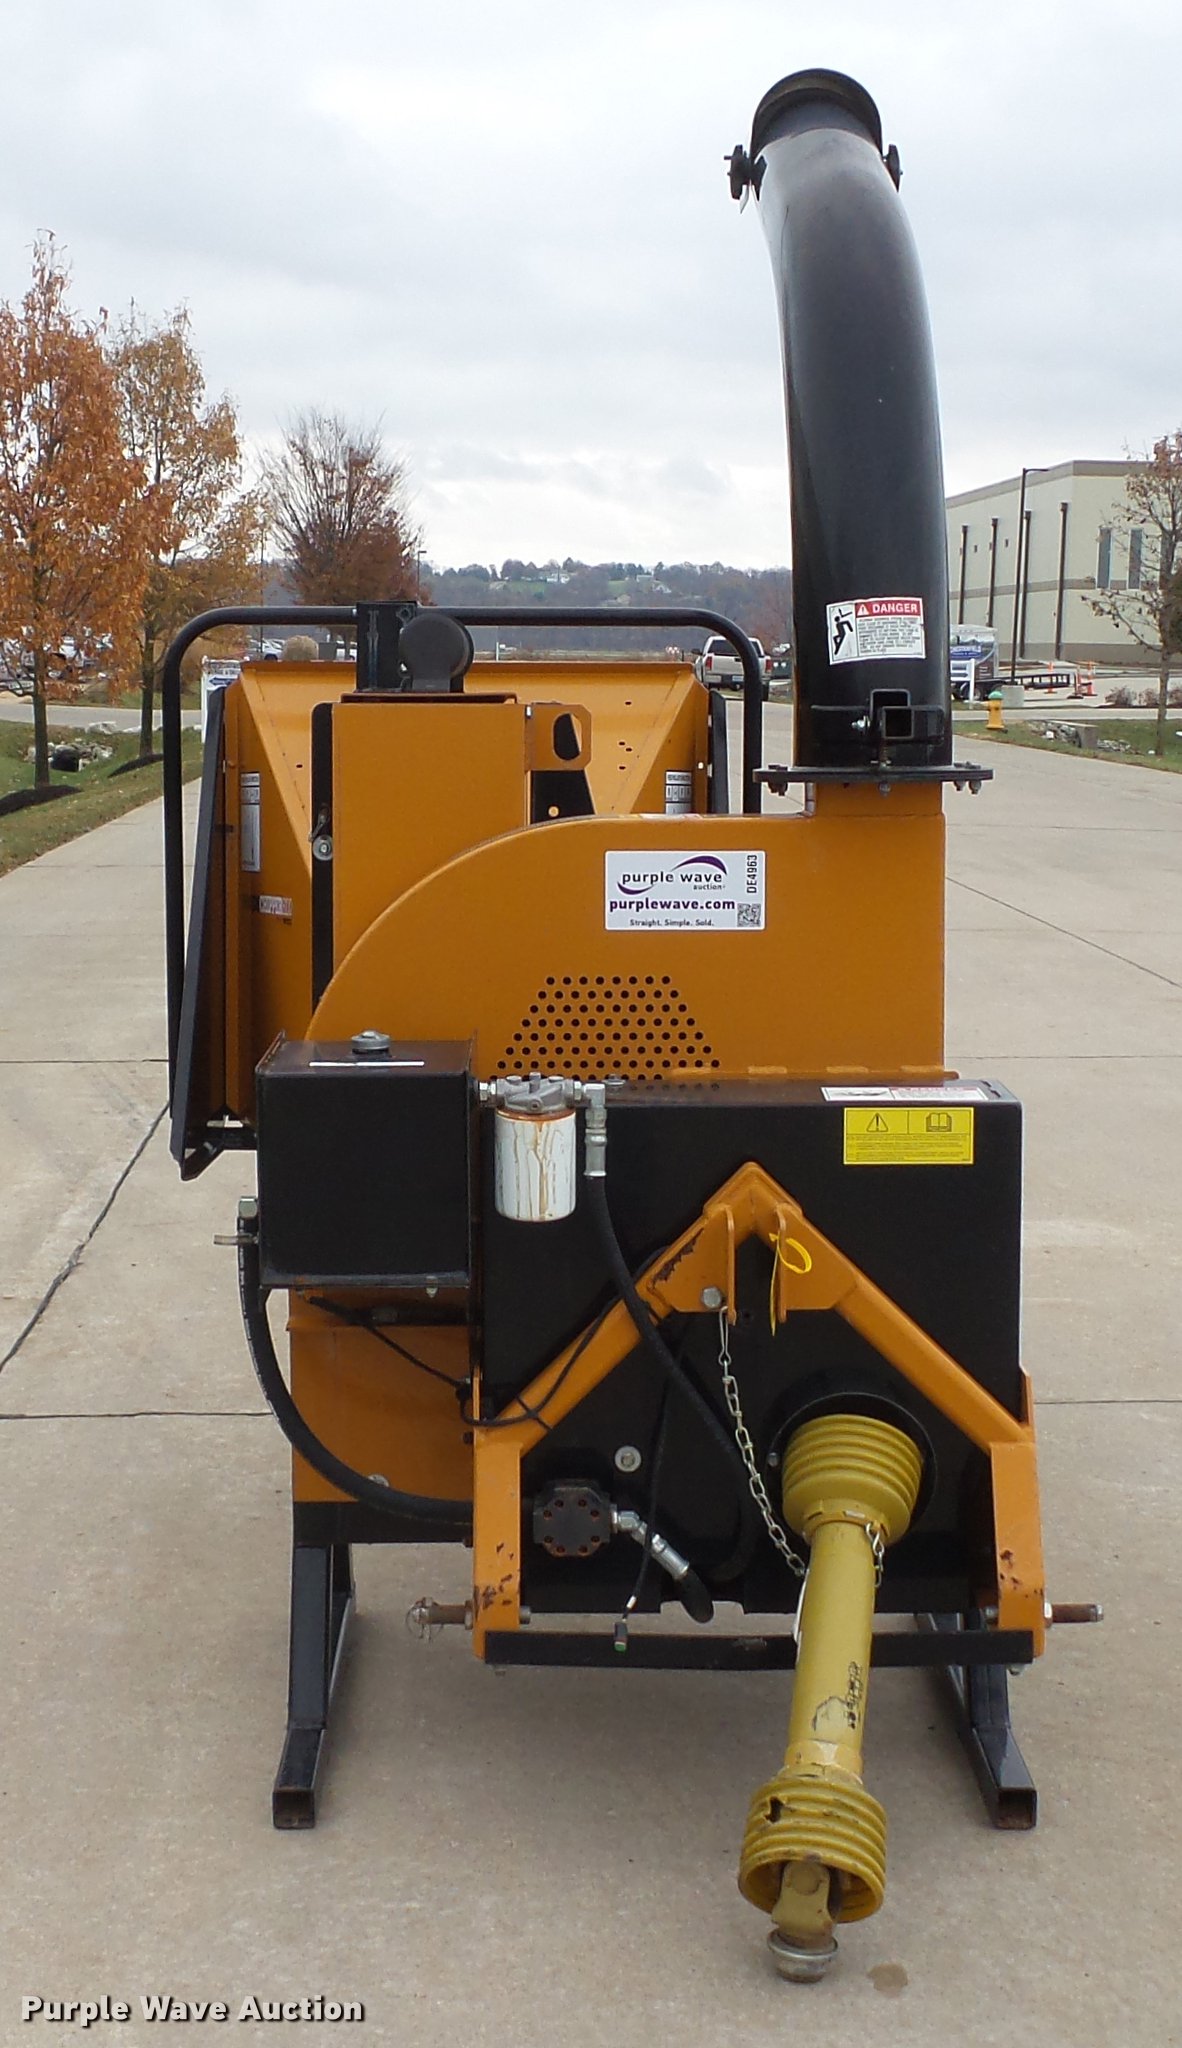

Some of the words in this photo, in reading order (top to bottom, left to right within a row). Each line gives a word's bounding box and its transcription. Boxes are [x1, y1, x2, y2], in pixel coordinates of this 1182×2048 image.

[872, 603, 918, 614] DANGER
[622, 871, 674, 885] purple
[680, 873, 722, 883] wave
[746, 854, 758, 894] DE4963
[609, 897, 735, 913] purplewave.com
[629, 918, 662, 928] Straight.
[664, 918, 693, 928] Simple.
[695, 918, 714, 927] Sold.
